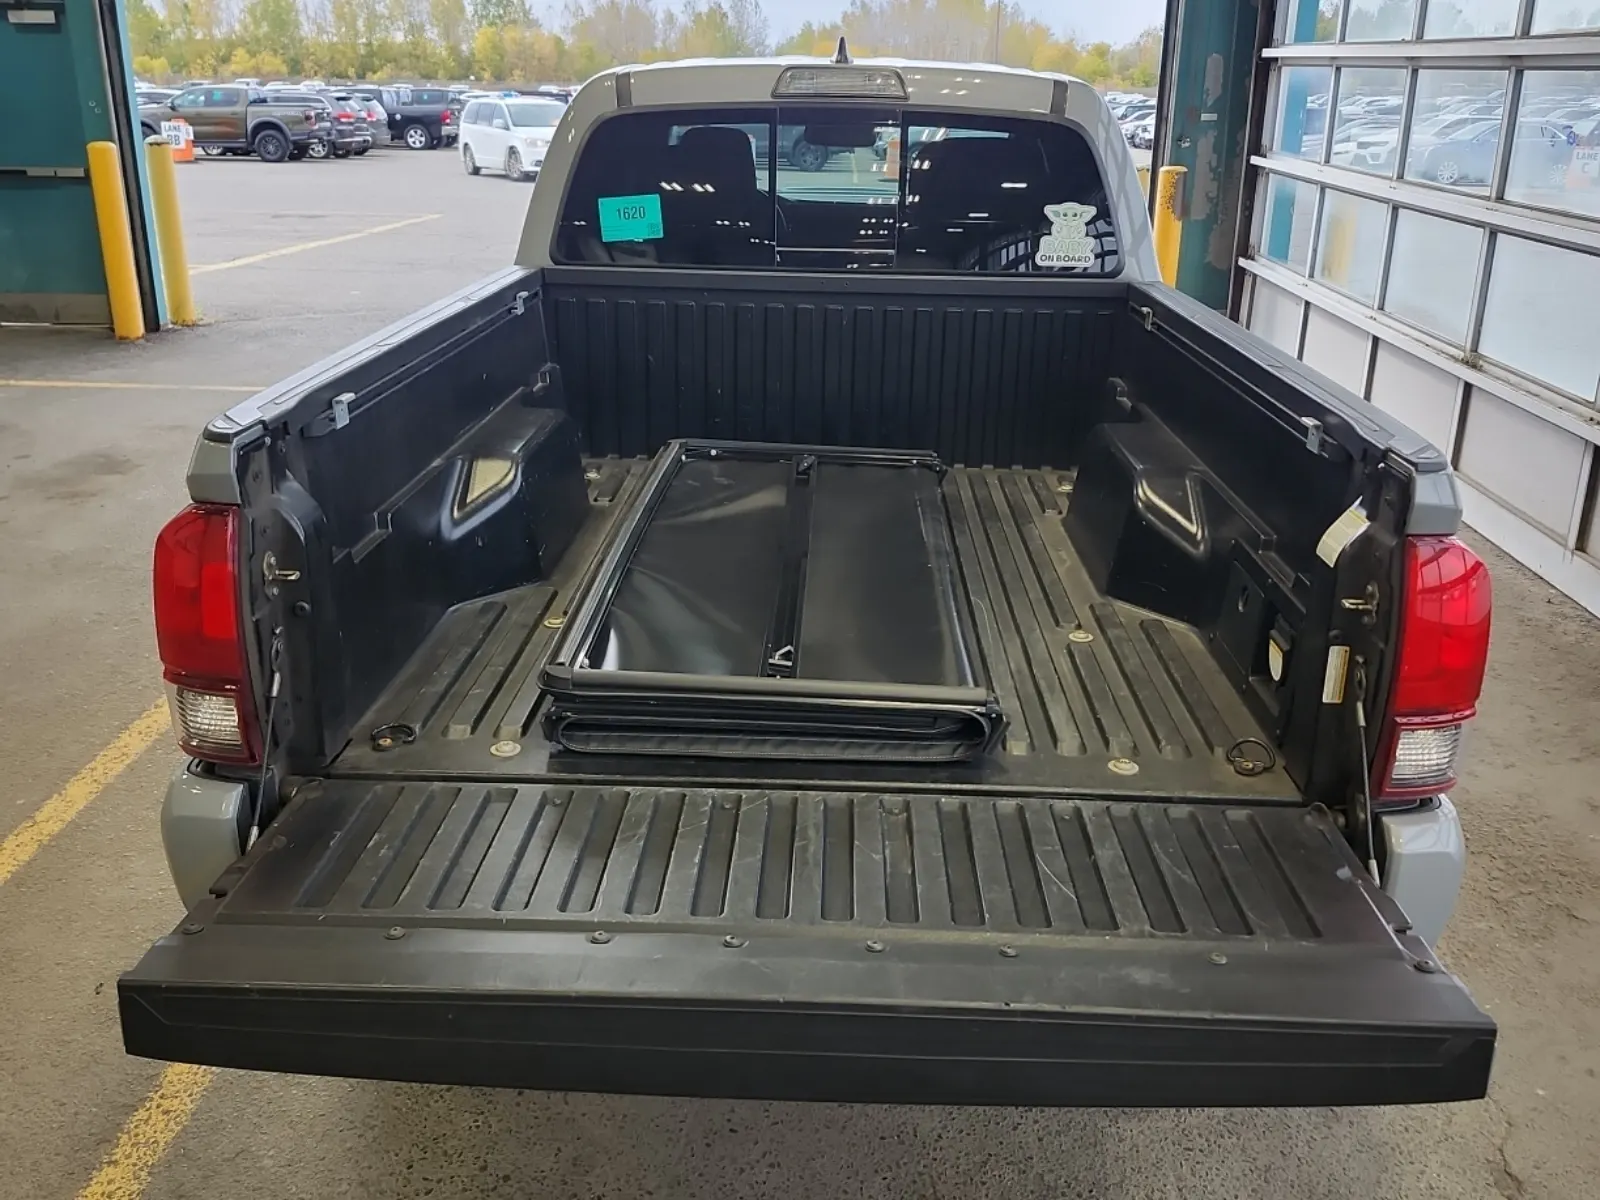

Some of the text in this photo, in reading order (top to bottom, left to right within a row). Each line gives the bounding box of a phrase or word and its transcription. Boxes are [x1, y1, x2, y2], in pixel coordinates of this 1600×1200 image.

[164, 124, 182, 132] LANE
[1576, 151, 1599, 161] LANE
[616, 206, 646, 221] 1620
[1042, 239, 1093, 255] BABY
[1040, 254, 1091, 263] ON BOARD
